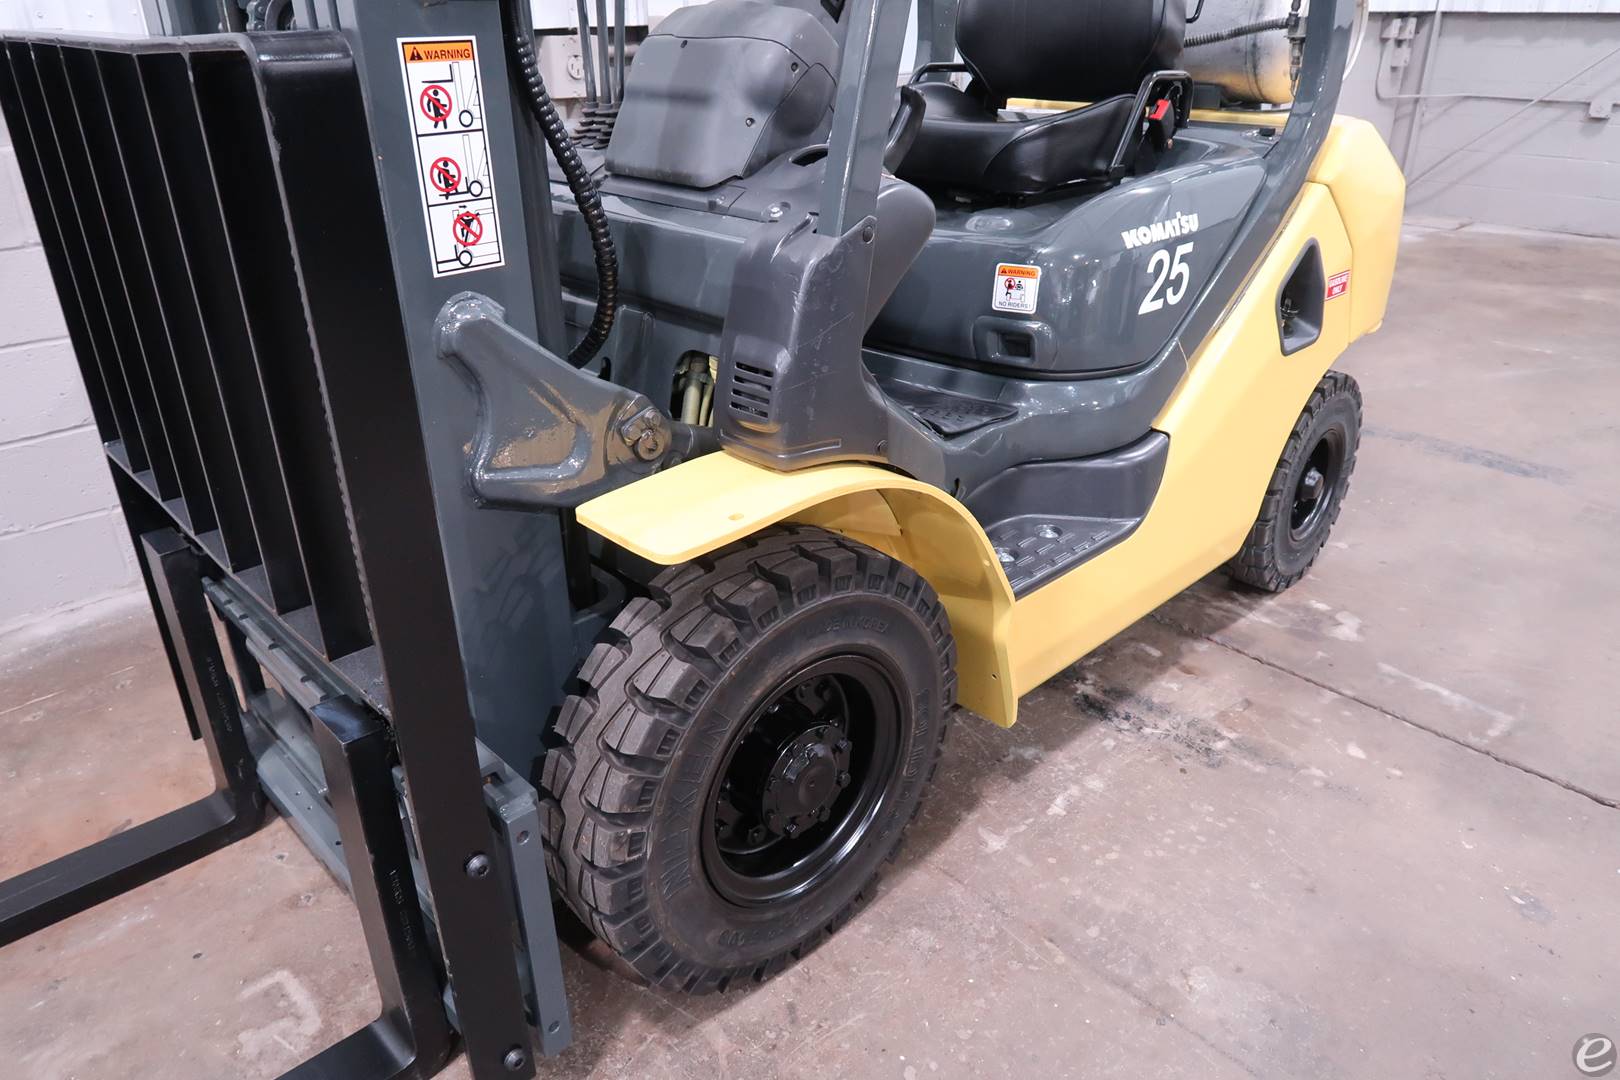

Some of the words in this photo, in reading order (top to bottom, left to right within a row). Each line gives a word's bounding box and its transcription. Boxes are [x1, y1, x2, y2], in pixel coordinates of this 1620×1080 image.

[424, 48, 471, 60] WARNING
[1121, 211, 1199, 250] KOMATSU
[1007, 269, 1036, 277] WARNING
[1137, 241, 1195, 316] 25
